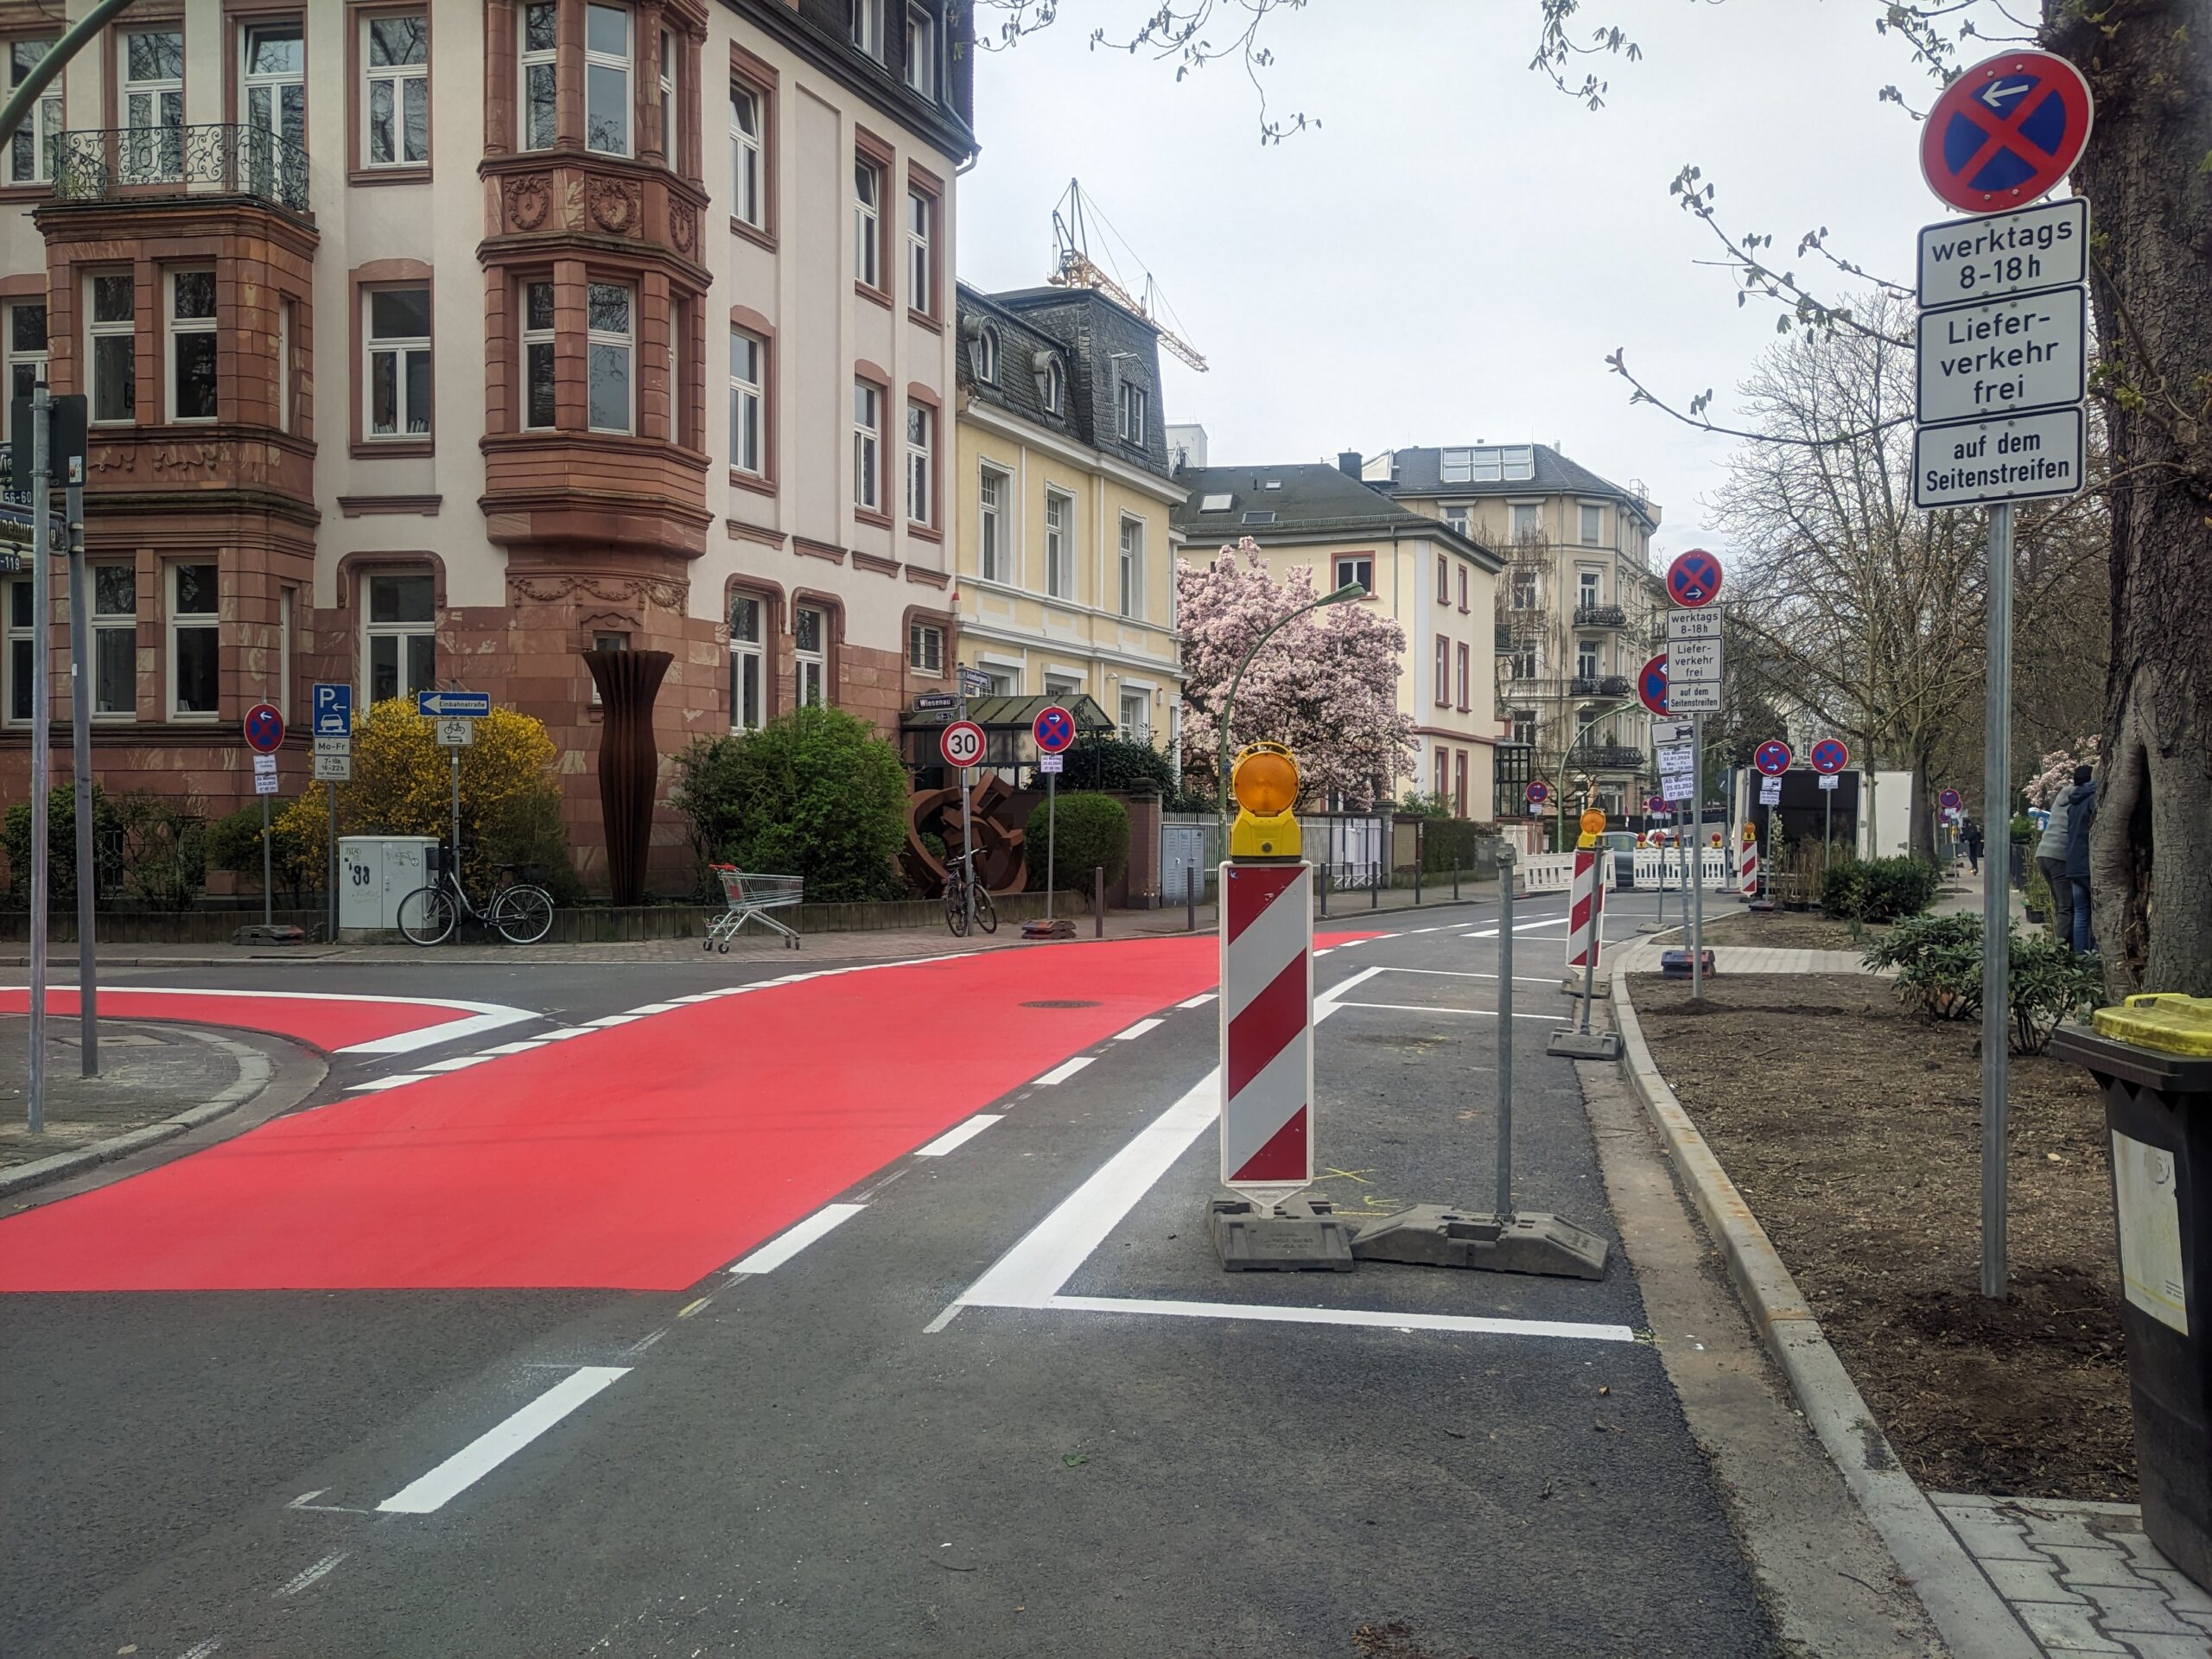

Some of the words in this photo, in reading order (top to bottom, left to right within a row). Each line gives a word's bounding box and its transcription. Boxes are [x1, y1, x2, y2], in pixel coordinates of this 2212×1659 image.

[1932, 220, 2073, 262] werktags
[1948, 313, 2050, 345] Liefer-
[1941, 340, 2059, 377] verkehr
[1974, 374, 2024, 404] frei
[1954, 435, 1986, 460] auf
[1998, 432, 2040, 454] dem
[1926, 457, 2069, 492] Seitenstreifen
[4, 491, 32, 504] 56-60
[1671, 613, 1719, 624] werktags
[1677, 644, 1712, 654] Liefer-
[1675, 655, 1714, 666] verkehr
[1686, 667, 1703, 677] frei
[320, 688, 335, 708] P
[1680, 688, 1691, 696] auf
[1694, 687, 1708, 696] dem
[1670, 697, 1718, 708] Seitenstreifen
[951, 734, 976, 754] 30
